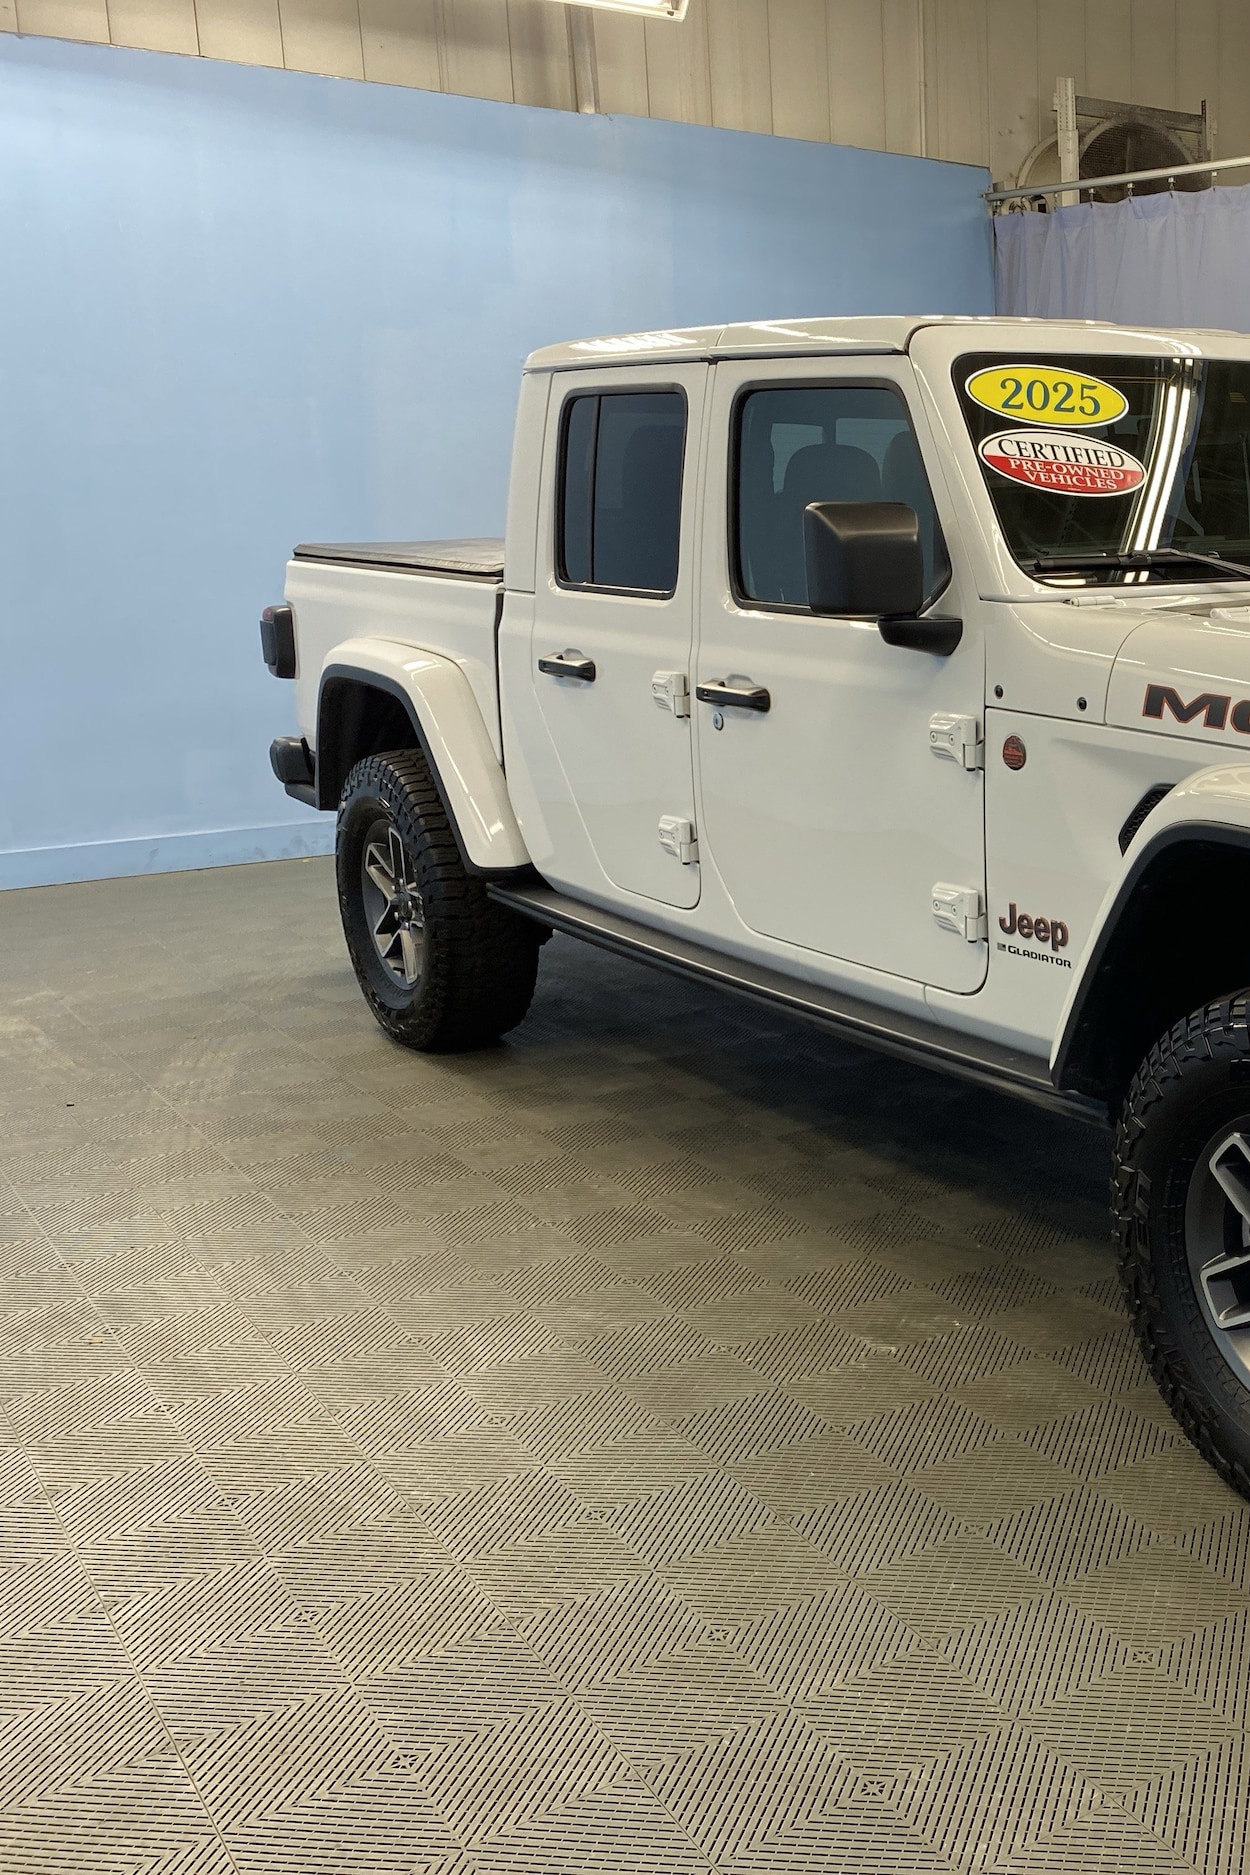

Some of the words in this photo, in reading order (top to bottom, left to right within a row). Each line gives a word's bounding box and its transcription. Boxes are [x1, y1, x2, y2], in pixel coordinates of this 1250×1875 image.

[1000, 378, 1100, 416] 2025
[998, 438, 1125, 468] CERTIFIED
[1008, 458, 1124, 481] PRE-OWNED
[1025, 471, 1117, 489] VEHICLES
[998, 901, 1069, 952] Jeep
[1008, 945, 1072, 969] GLADIATOR
